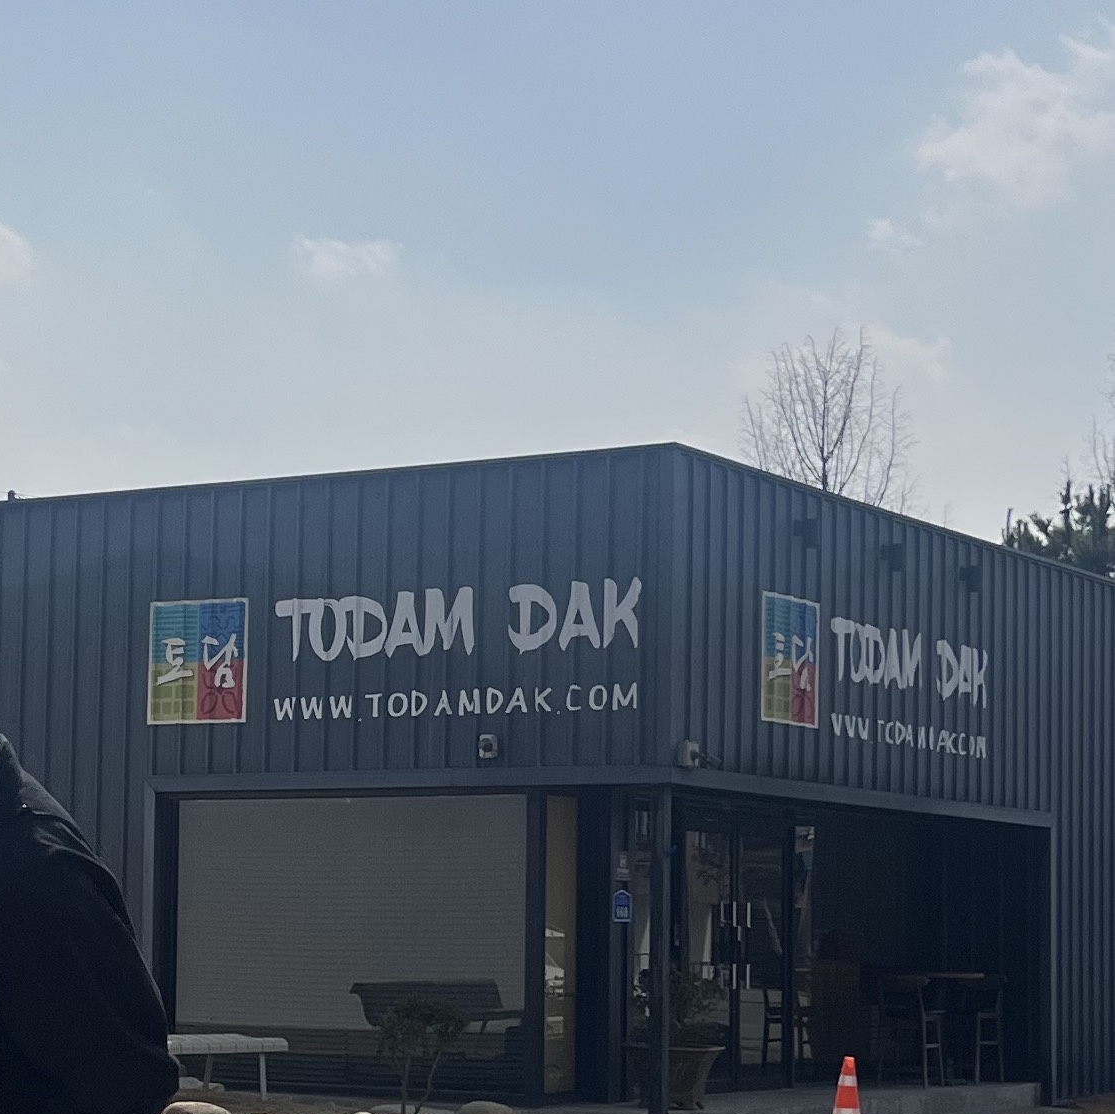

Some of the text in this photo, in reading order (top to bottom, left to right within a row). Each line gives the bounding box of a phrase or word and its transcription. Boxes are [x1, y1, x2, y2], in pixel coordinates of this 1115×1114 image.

[275, 576, 642, 661] TODAM DAK
[156, 633, 239, 688] 토담
[830, 617, 989, 709] TODAM DAK
[274, 683, 638, 722] WWW.TODAMDAK.COM
